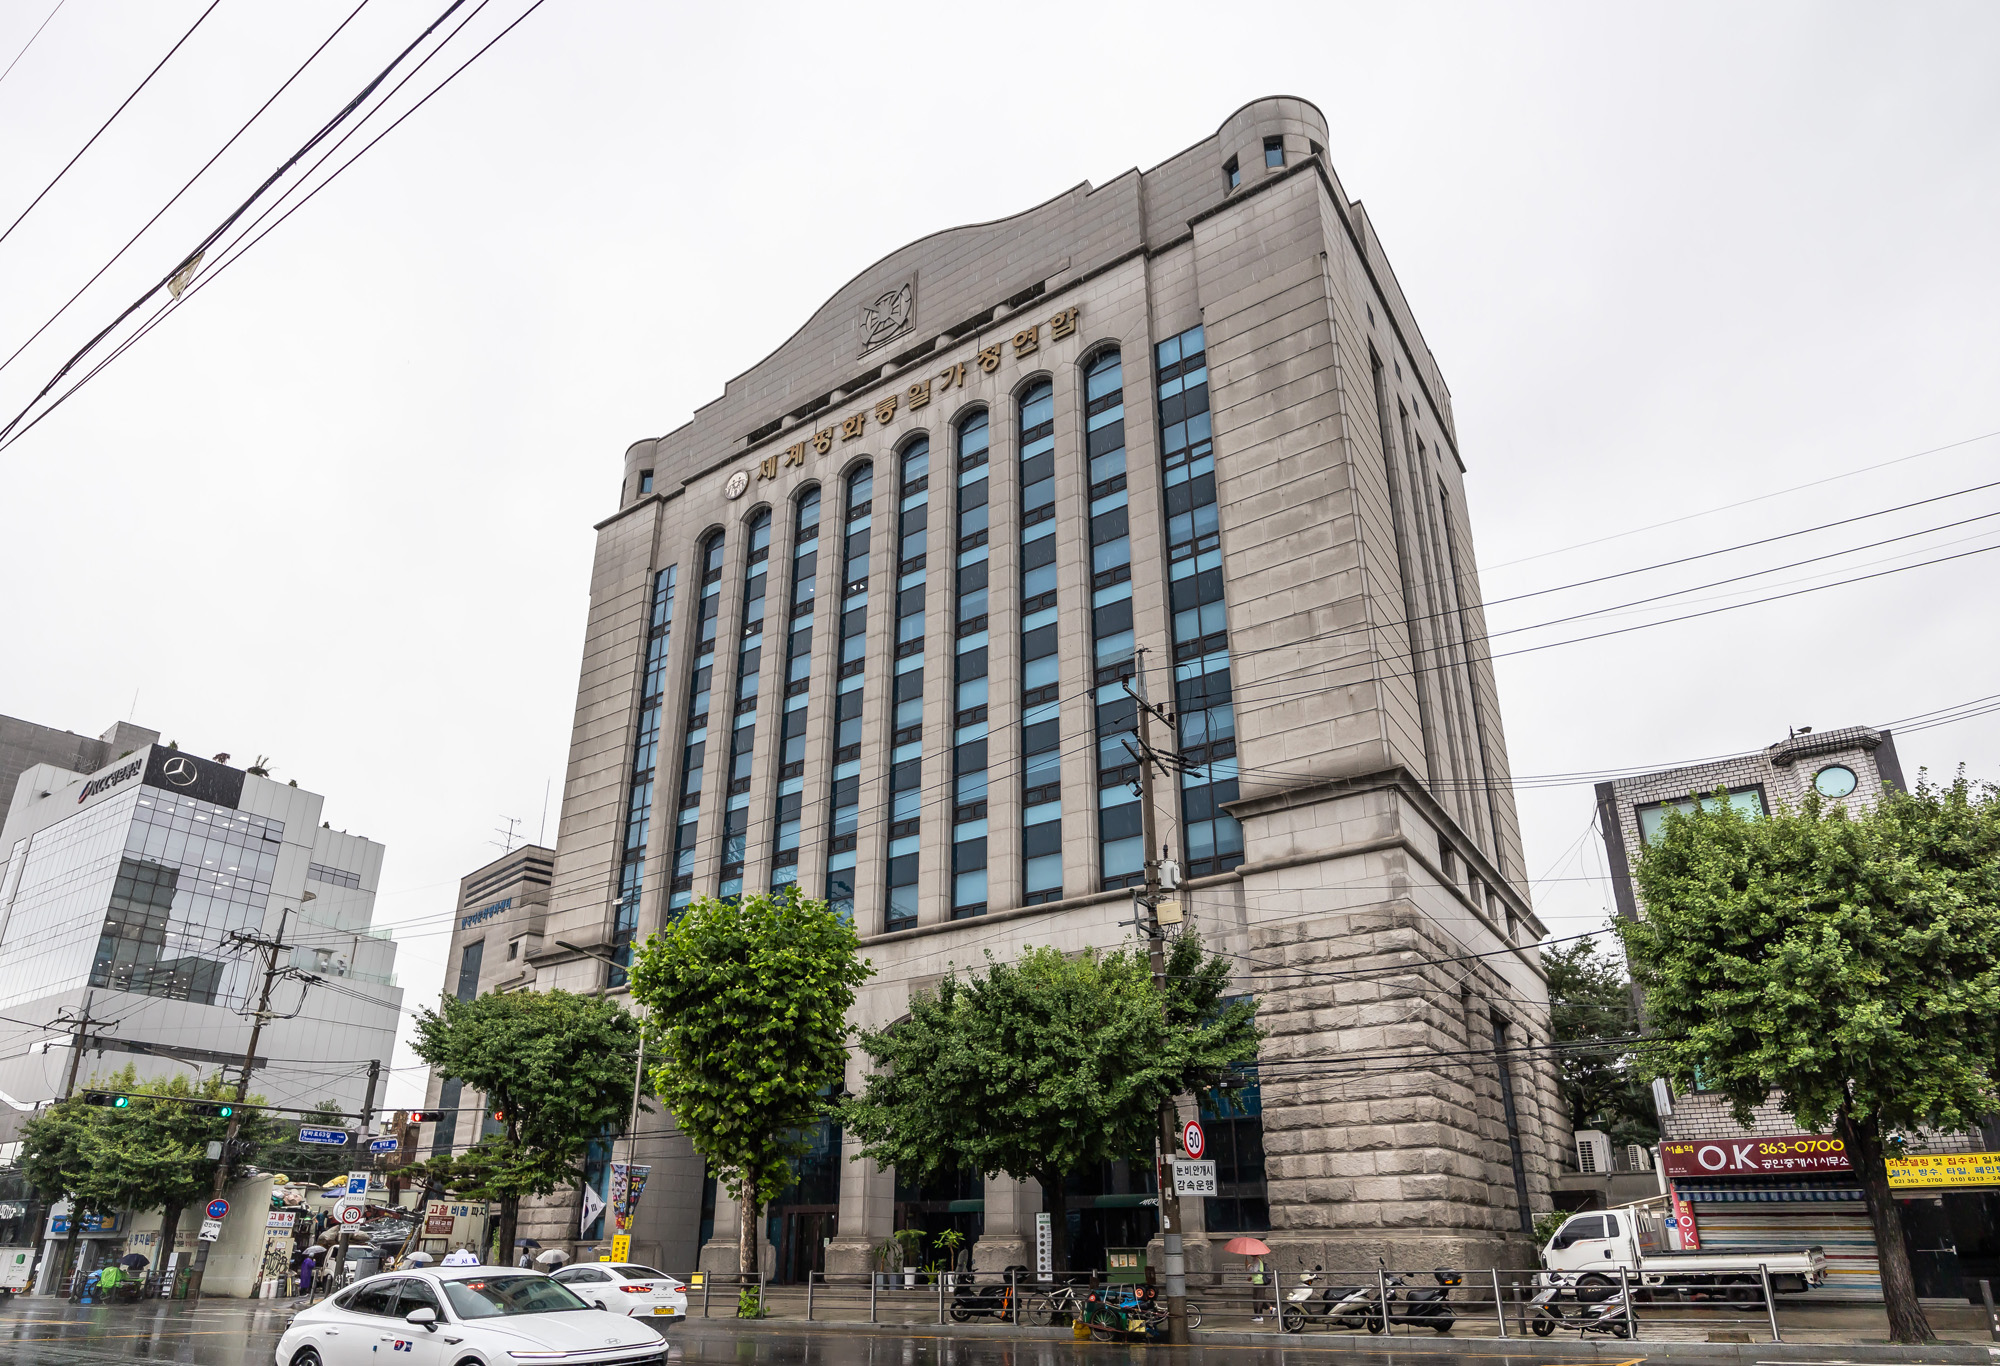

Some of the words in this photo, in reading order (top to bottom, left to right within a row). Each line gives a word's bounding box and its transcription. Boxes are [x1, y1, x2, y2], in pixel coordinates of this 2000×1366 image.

[756, 306, 1080, 482] 세계평화통일가정연합
[1188, 1132, 1200, 1148] 50
[1665, 1144, 1694, 1154] 서울역
[1758, 1139, 1845, 1155] 363-0700
[1697, 1143, 1759, 1171] O.K
[1761, 1157, 1818, 1169] 공인중개사
[1820, 1156, 1849, 1166] 사무소
[1889, 1158, 1929, 1168] 리모델링
[1933, 1158, 1942, 1166] 및
[1947, 1157, 1978, 1166] 집수리
[1177, 1179, 1214, 1191] 감속운행
[345, 1211, 358, 1219] 30
[429, 1204, 449, 1216] 고철
[451, 1205, 469, 1217] 비철
[269, 1212, 294, 1222] 고물상
[203, 1220, 221, 1229] 견인지역
